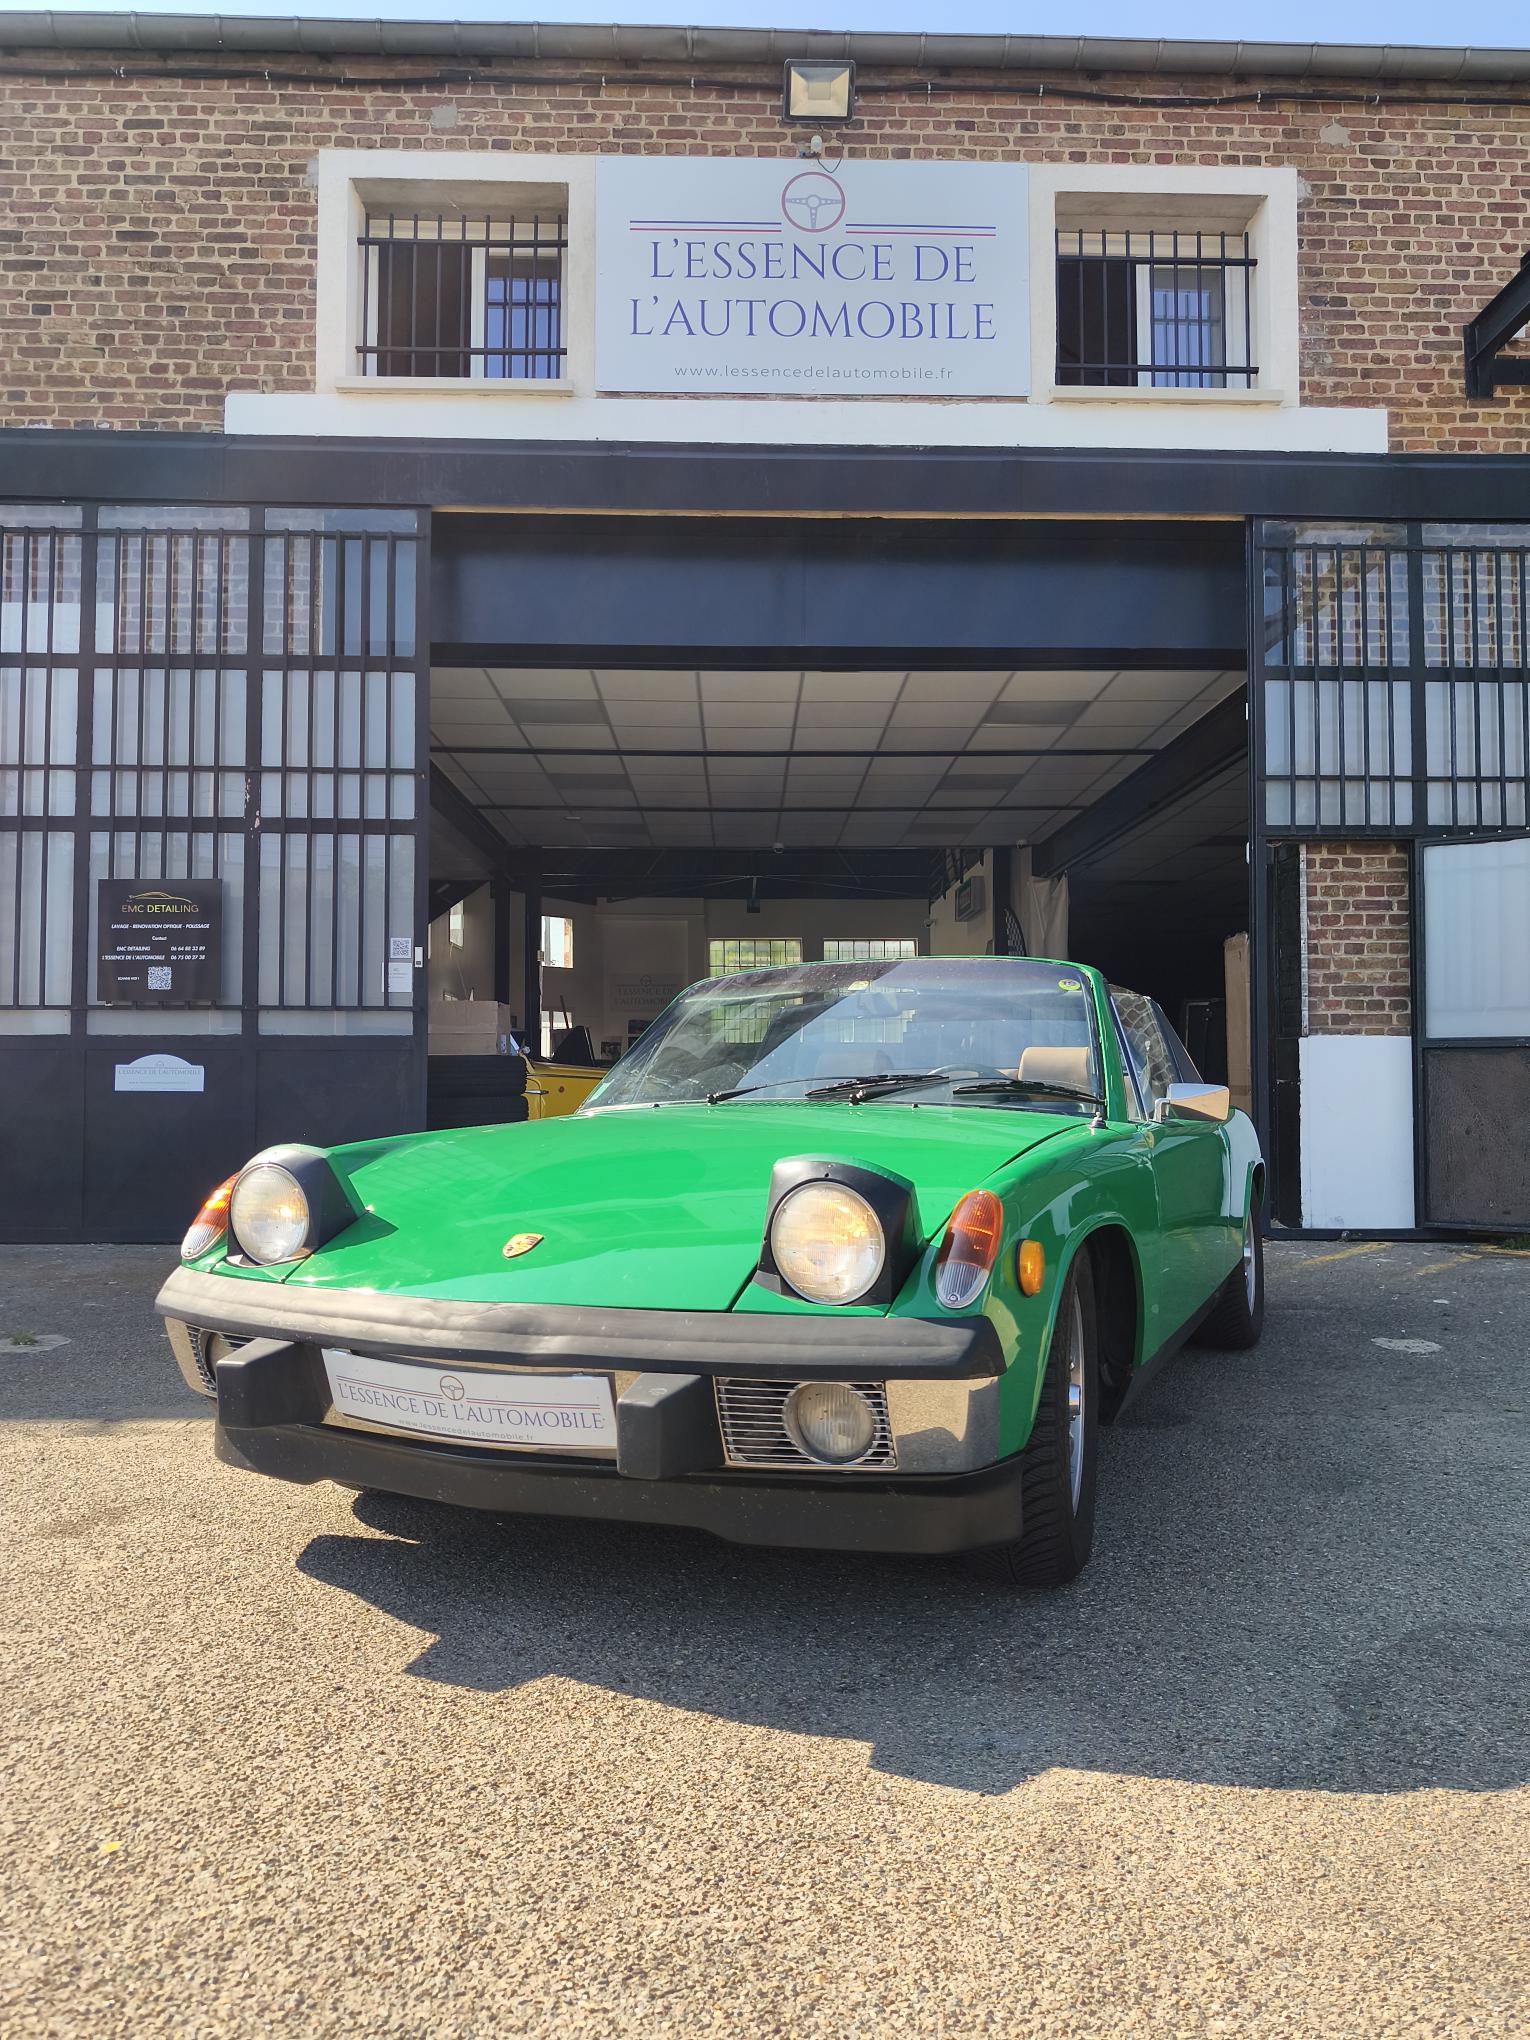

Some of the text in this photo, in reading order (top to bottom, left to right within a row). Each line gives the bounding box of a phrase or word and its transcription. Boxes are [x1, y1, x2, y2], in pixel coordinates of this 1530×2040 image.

[650, 239, 977, 283] L'ESSENCE DE
[629, 297, 997, 341] L'AUTOMOBILE
[674, 365, 953, 381] www.lessencedelautomobile.fr
[121, 904, 199, 913] EMC DETAILING
[337, 1382, 603, 1430] L'ESSENCE DE L'AUTOMOBILE
[398, 1418, 534, 1441] www.lessencedelautomobile.fr
